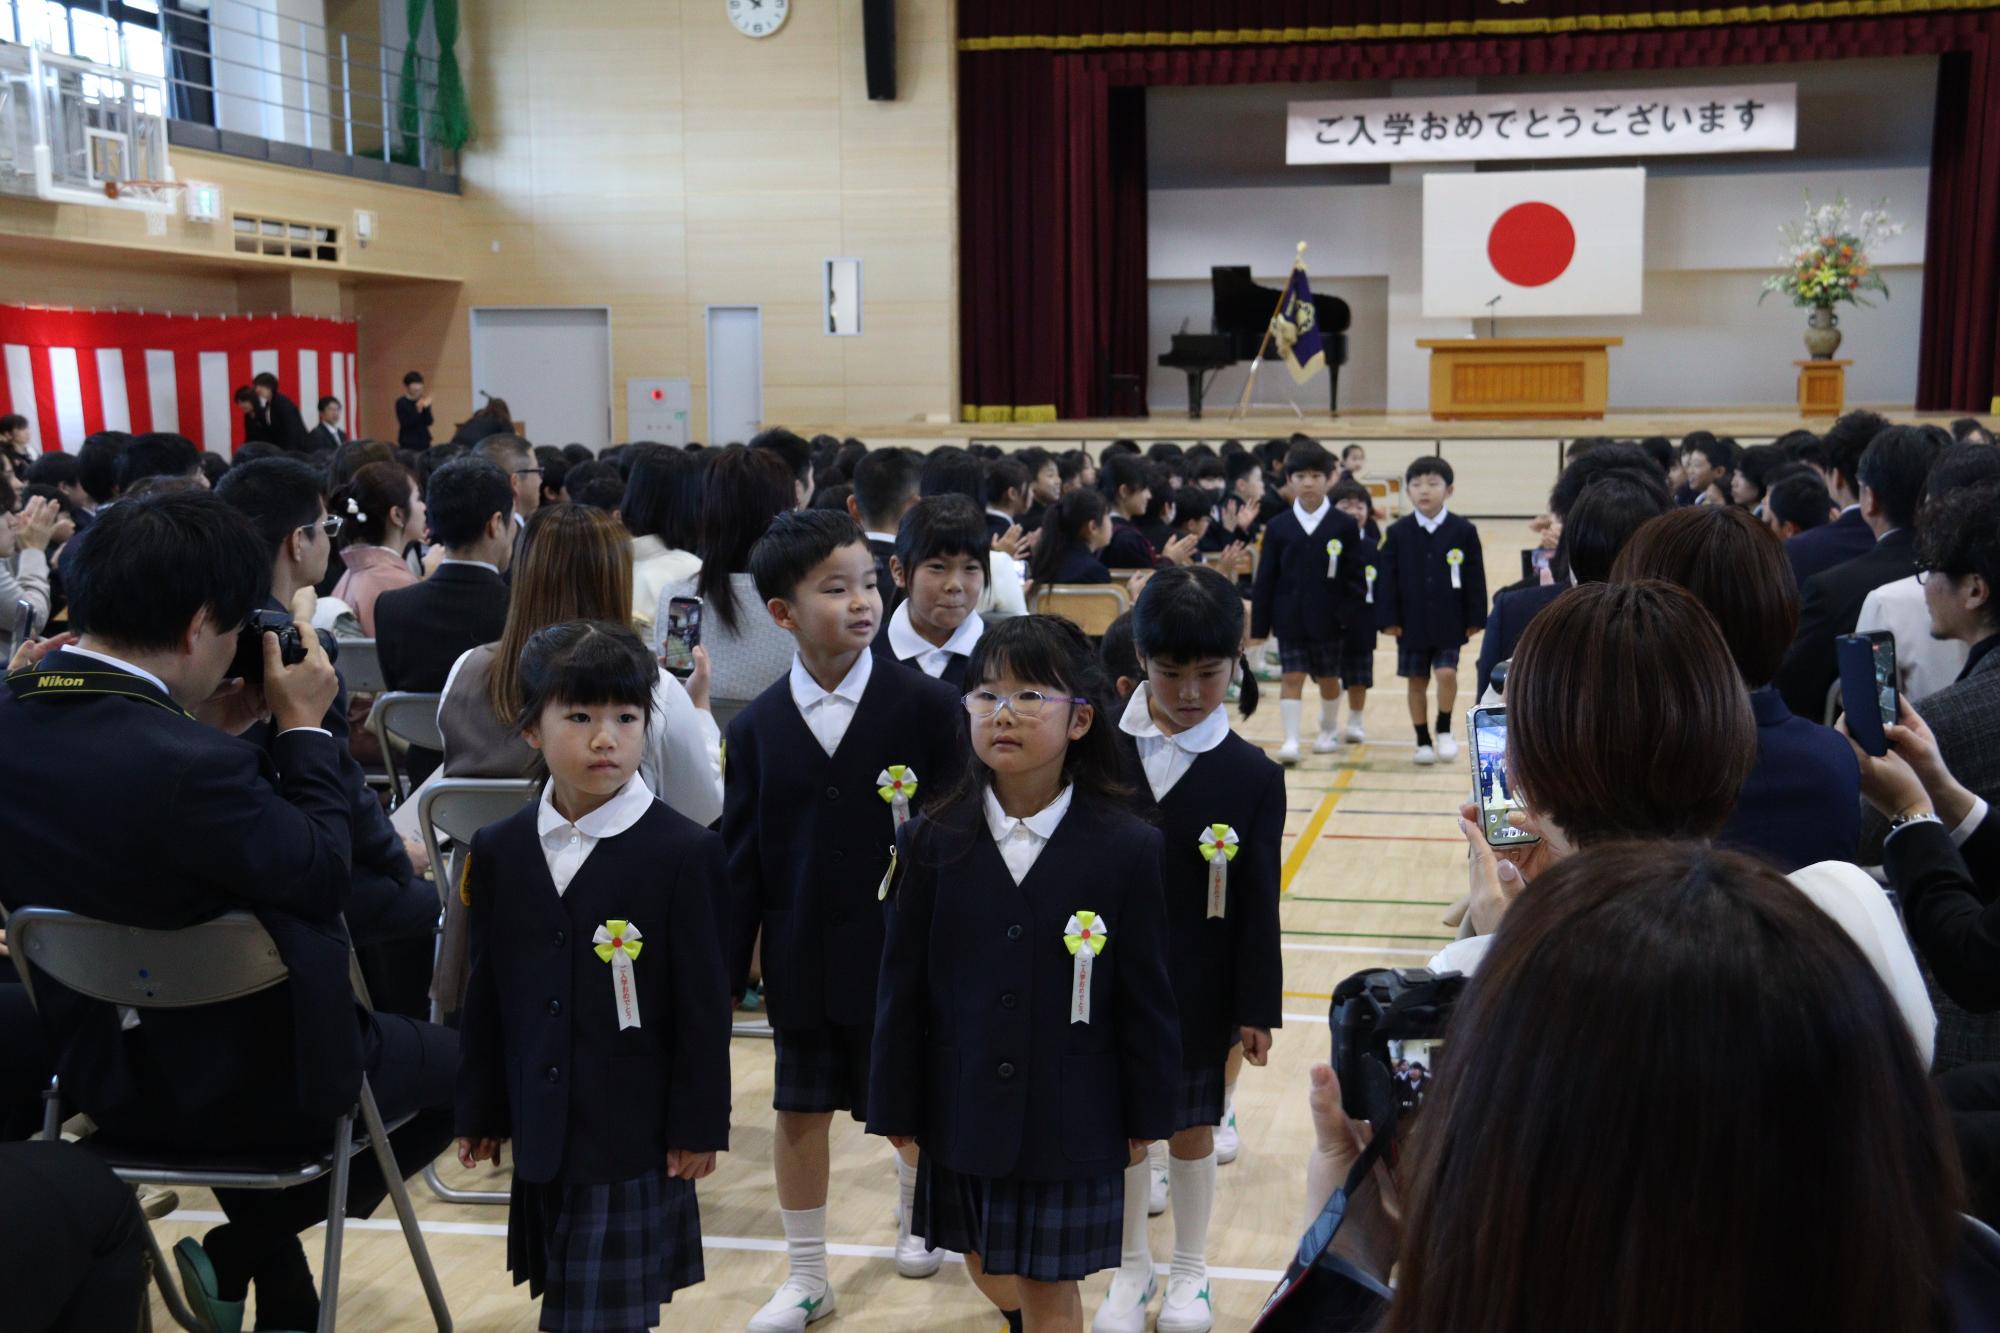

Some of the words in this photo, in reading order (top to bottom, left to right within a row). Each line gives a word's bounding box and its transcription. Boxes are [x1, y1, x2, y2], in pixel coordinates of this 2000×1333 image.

[753, 23, 763, 33] 6
[1314, 99, 1764, 146] ご入学おめでとうございます
[37, 675, 85, 688] Nikon
